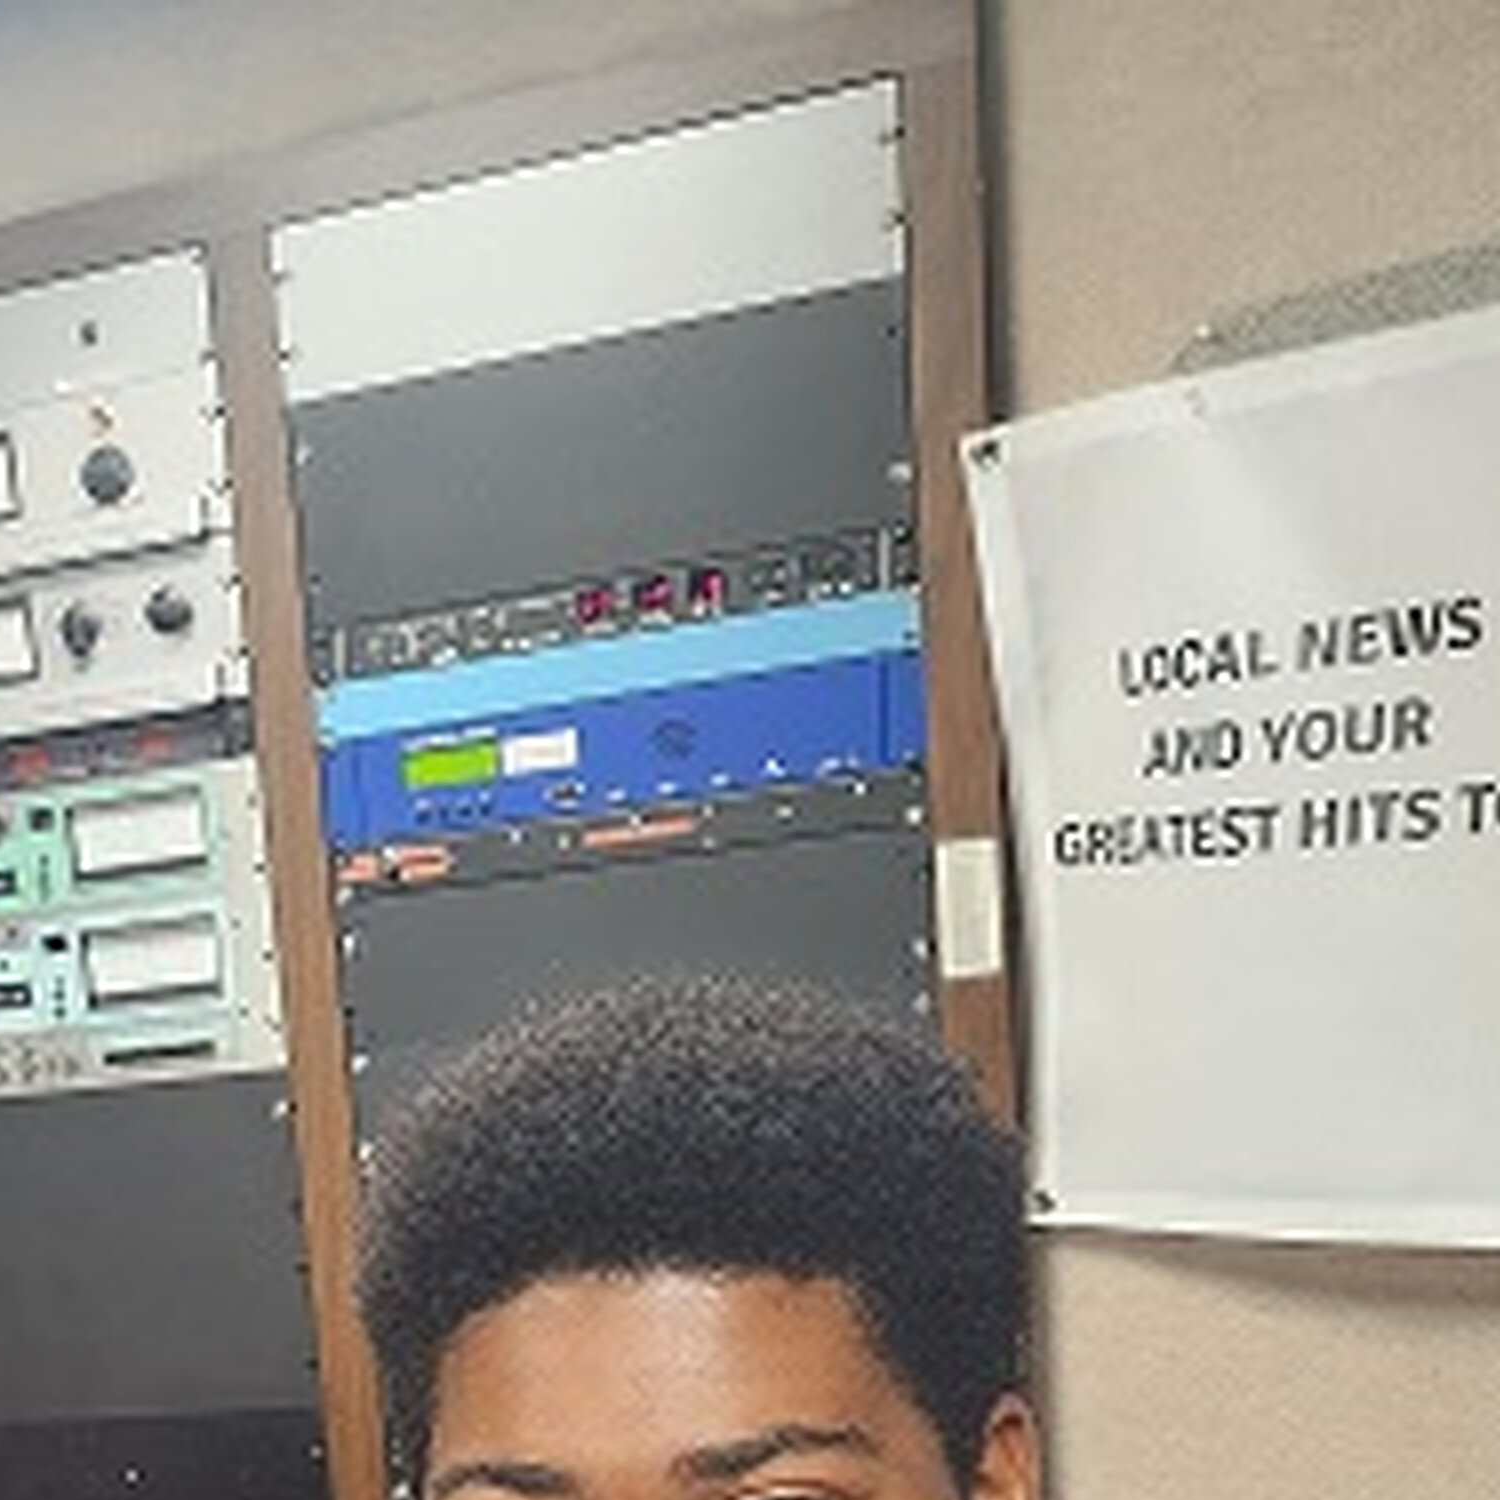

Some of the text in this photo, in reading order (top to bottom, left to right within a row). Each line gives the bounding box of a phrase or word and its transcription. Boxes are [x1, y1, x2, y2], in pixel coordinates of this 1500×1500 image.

[1121, 598, 1484, 697] LOCAL NEWS
[1144, 696, 1432, 776] AND YOUR
[1056, 782, 1500, 865] GREATEST HITS T
